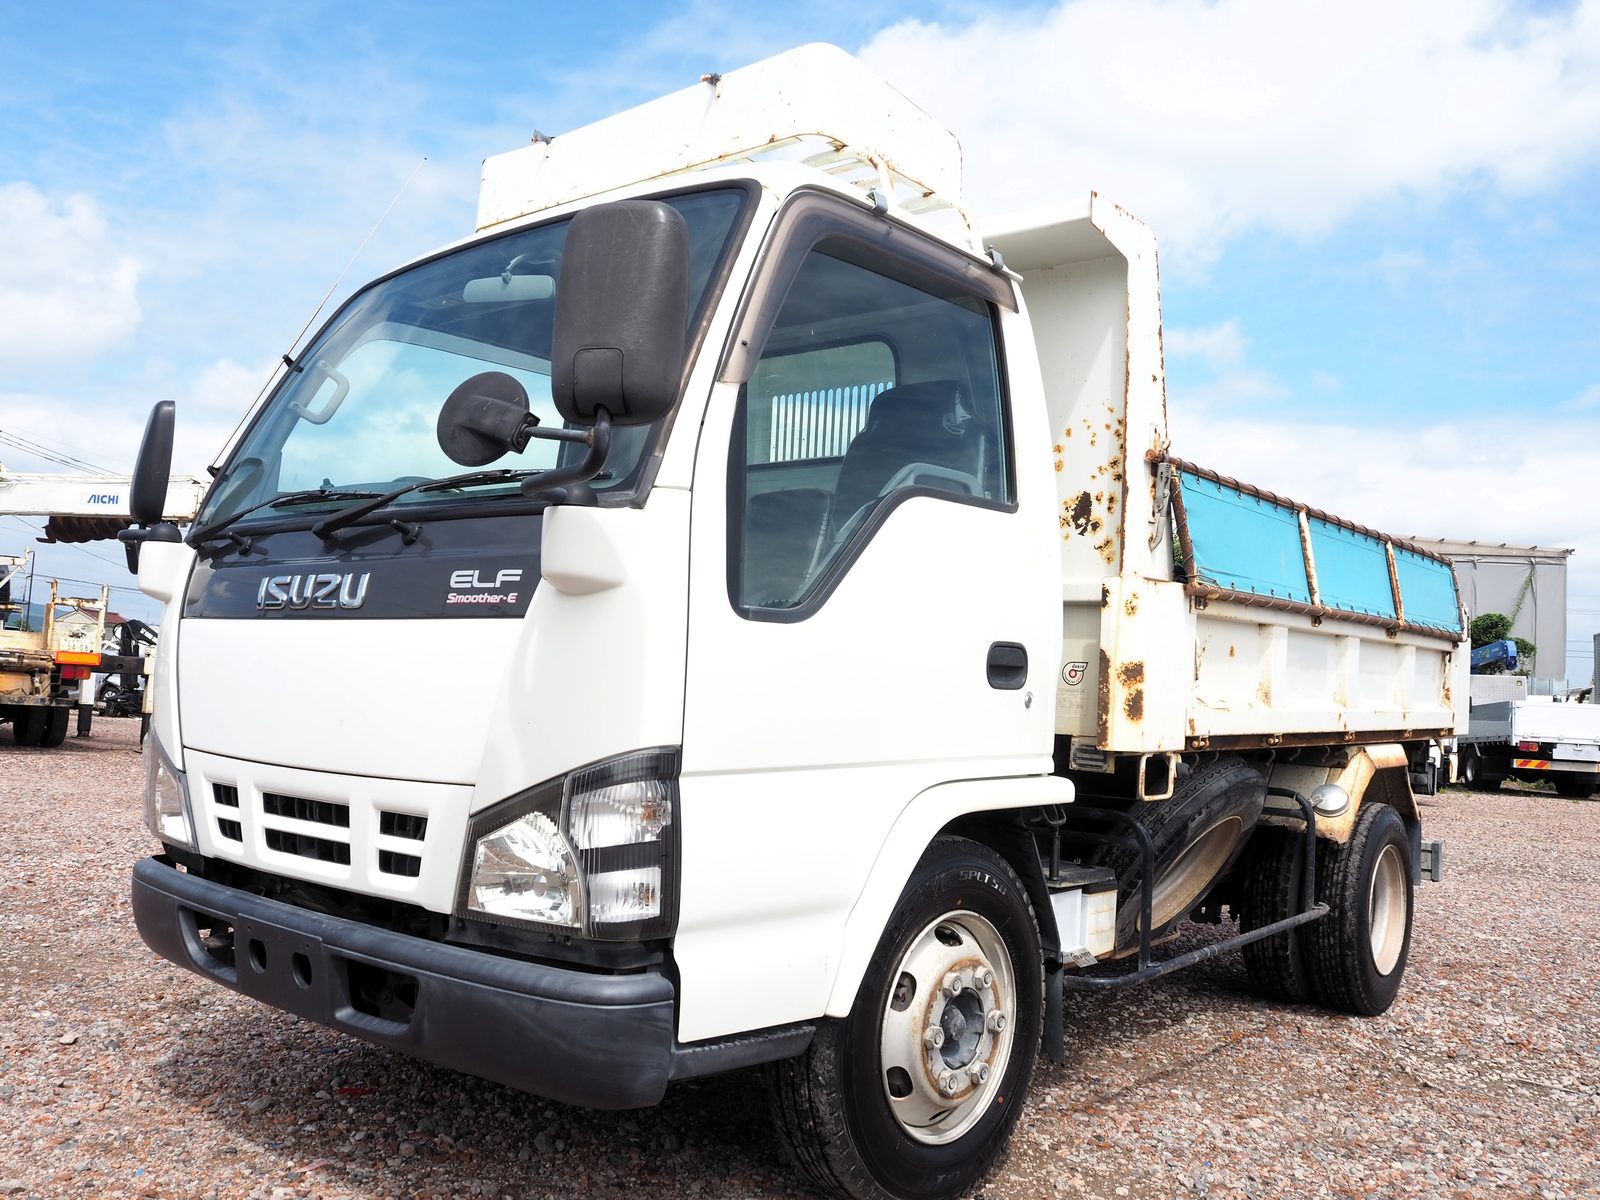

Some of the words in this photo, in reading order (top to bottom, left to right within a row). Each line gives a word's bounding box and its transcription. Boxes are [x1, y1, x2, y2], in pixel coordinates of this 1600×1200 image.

[87, 494, 119, 504] AICHI
[449, 569, 523, 588] ELF
[256, 572, 371, 610] ISUZU
